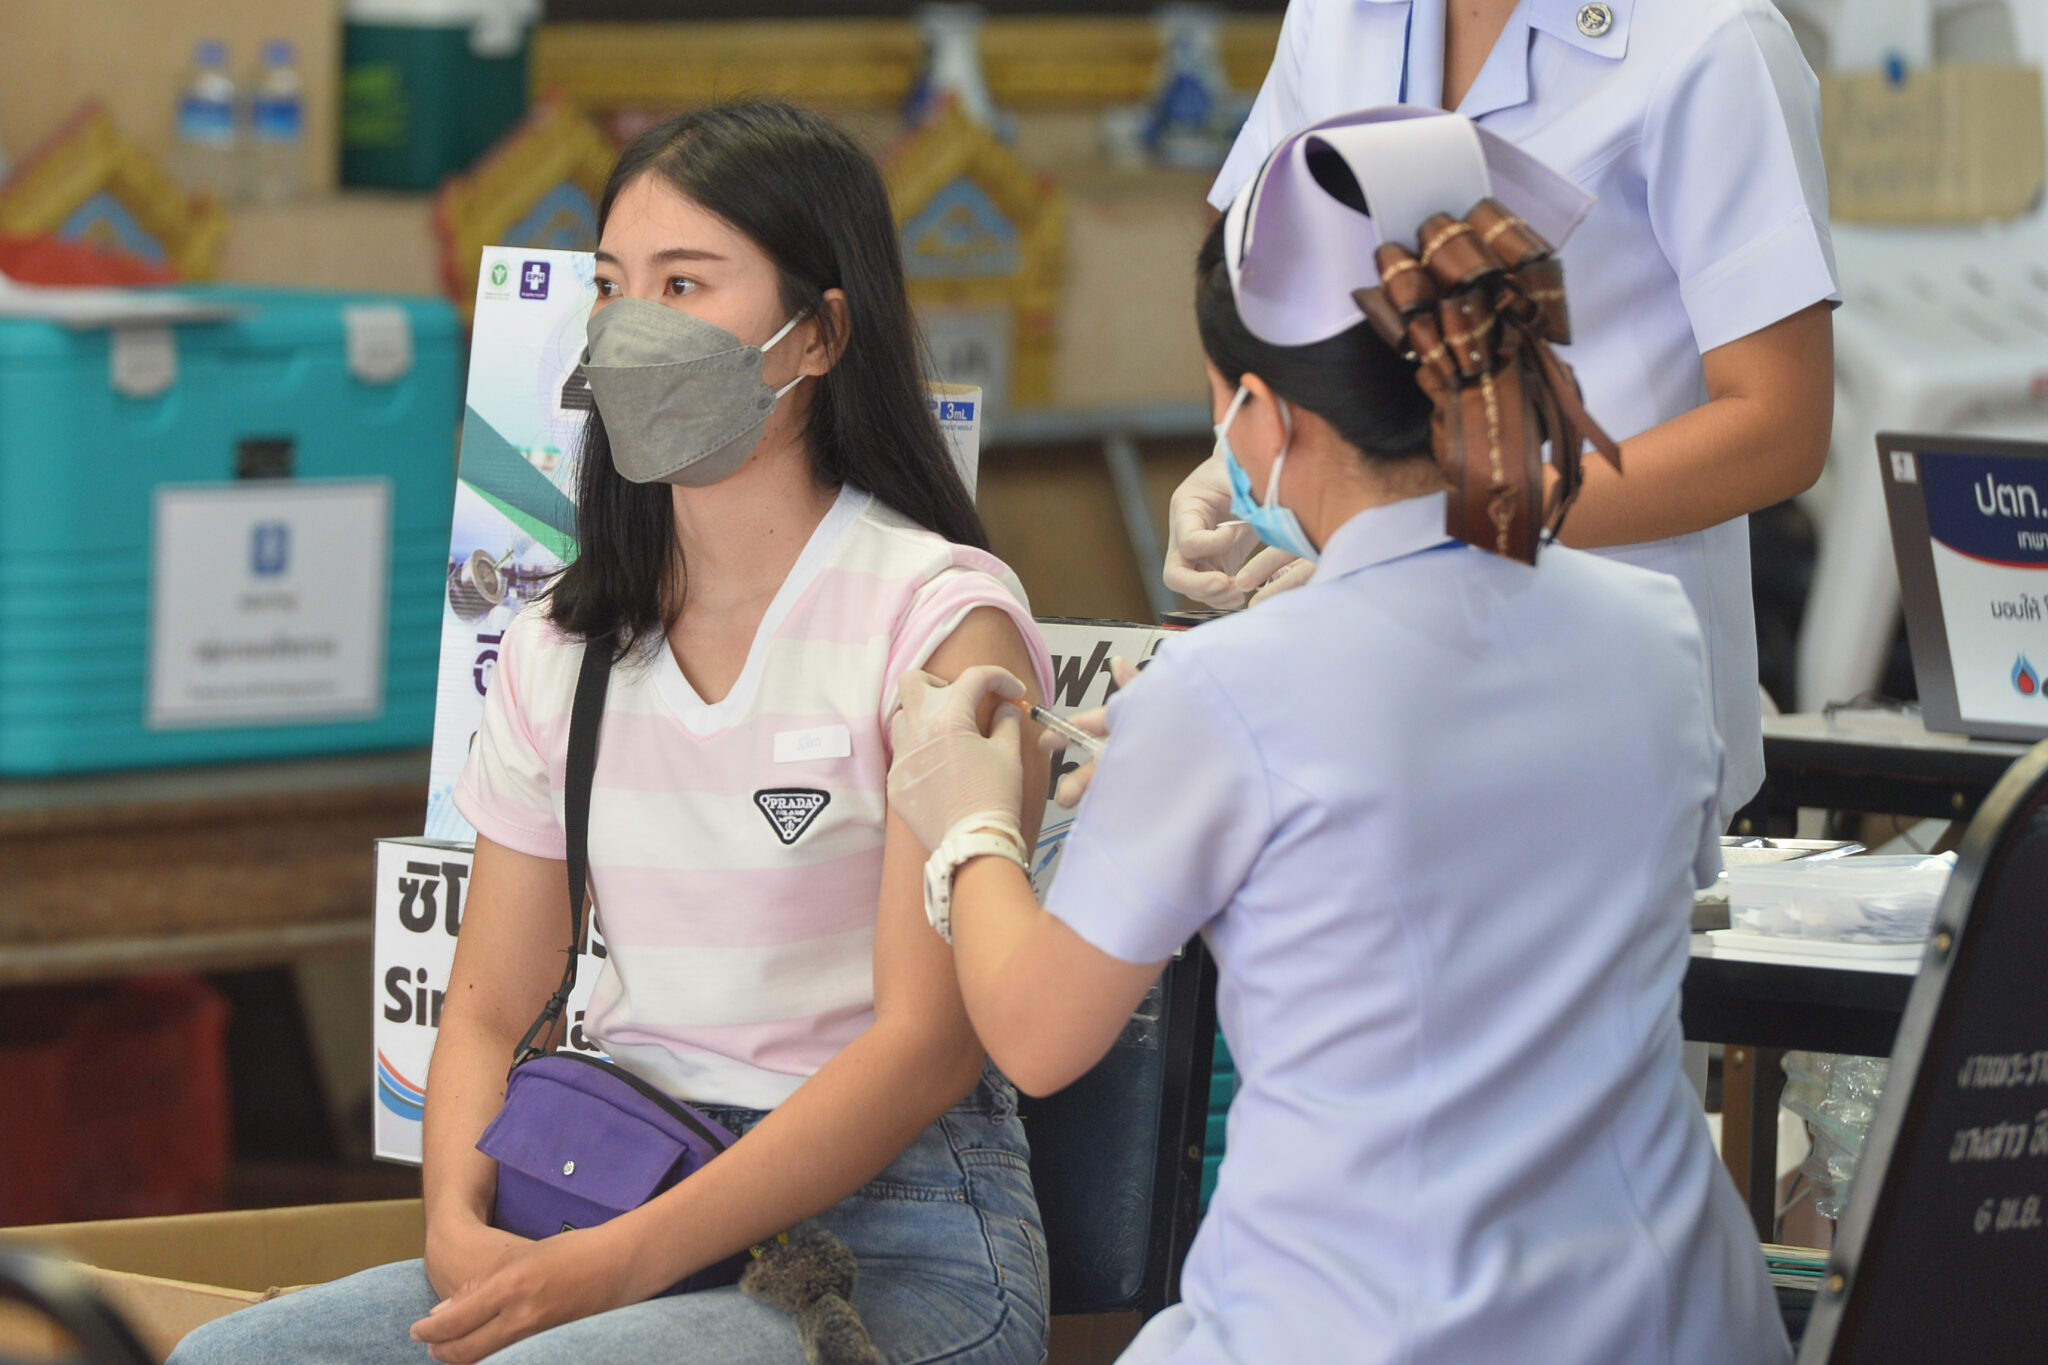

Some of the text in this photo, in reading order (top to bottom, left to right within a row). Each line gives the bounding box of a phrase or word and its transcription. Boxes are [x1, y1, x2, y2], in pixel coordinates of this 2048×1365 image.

[946, 402, 967, 420] 3mL
[1974, 472, 2048, 518] ปตท.
[1990, 592, 2041, 622] มอบให้
[769, 797, 814, 809] PRADA
